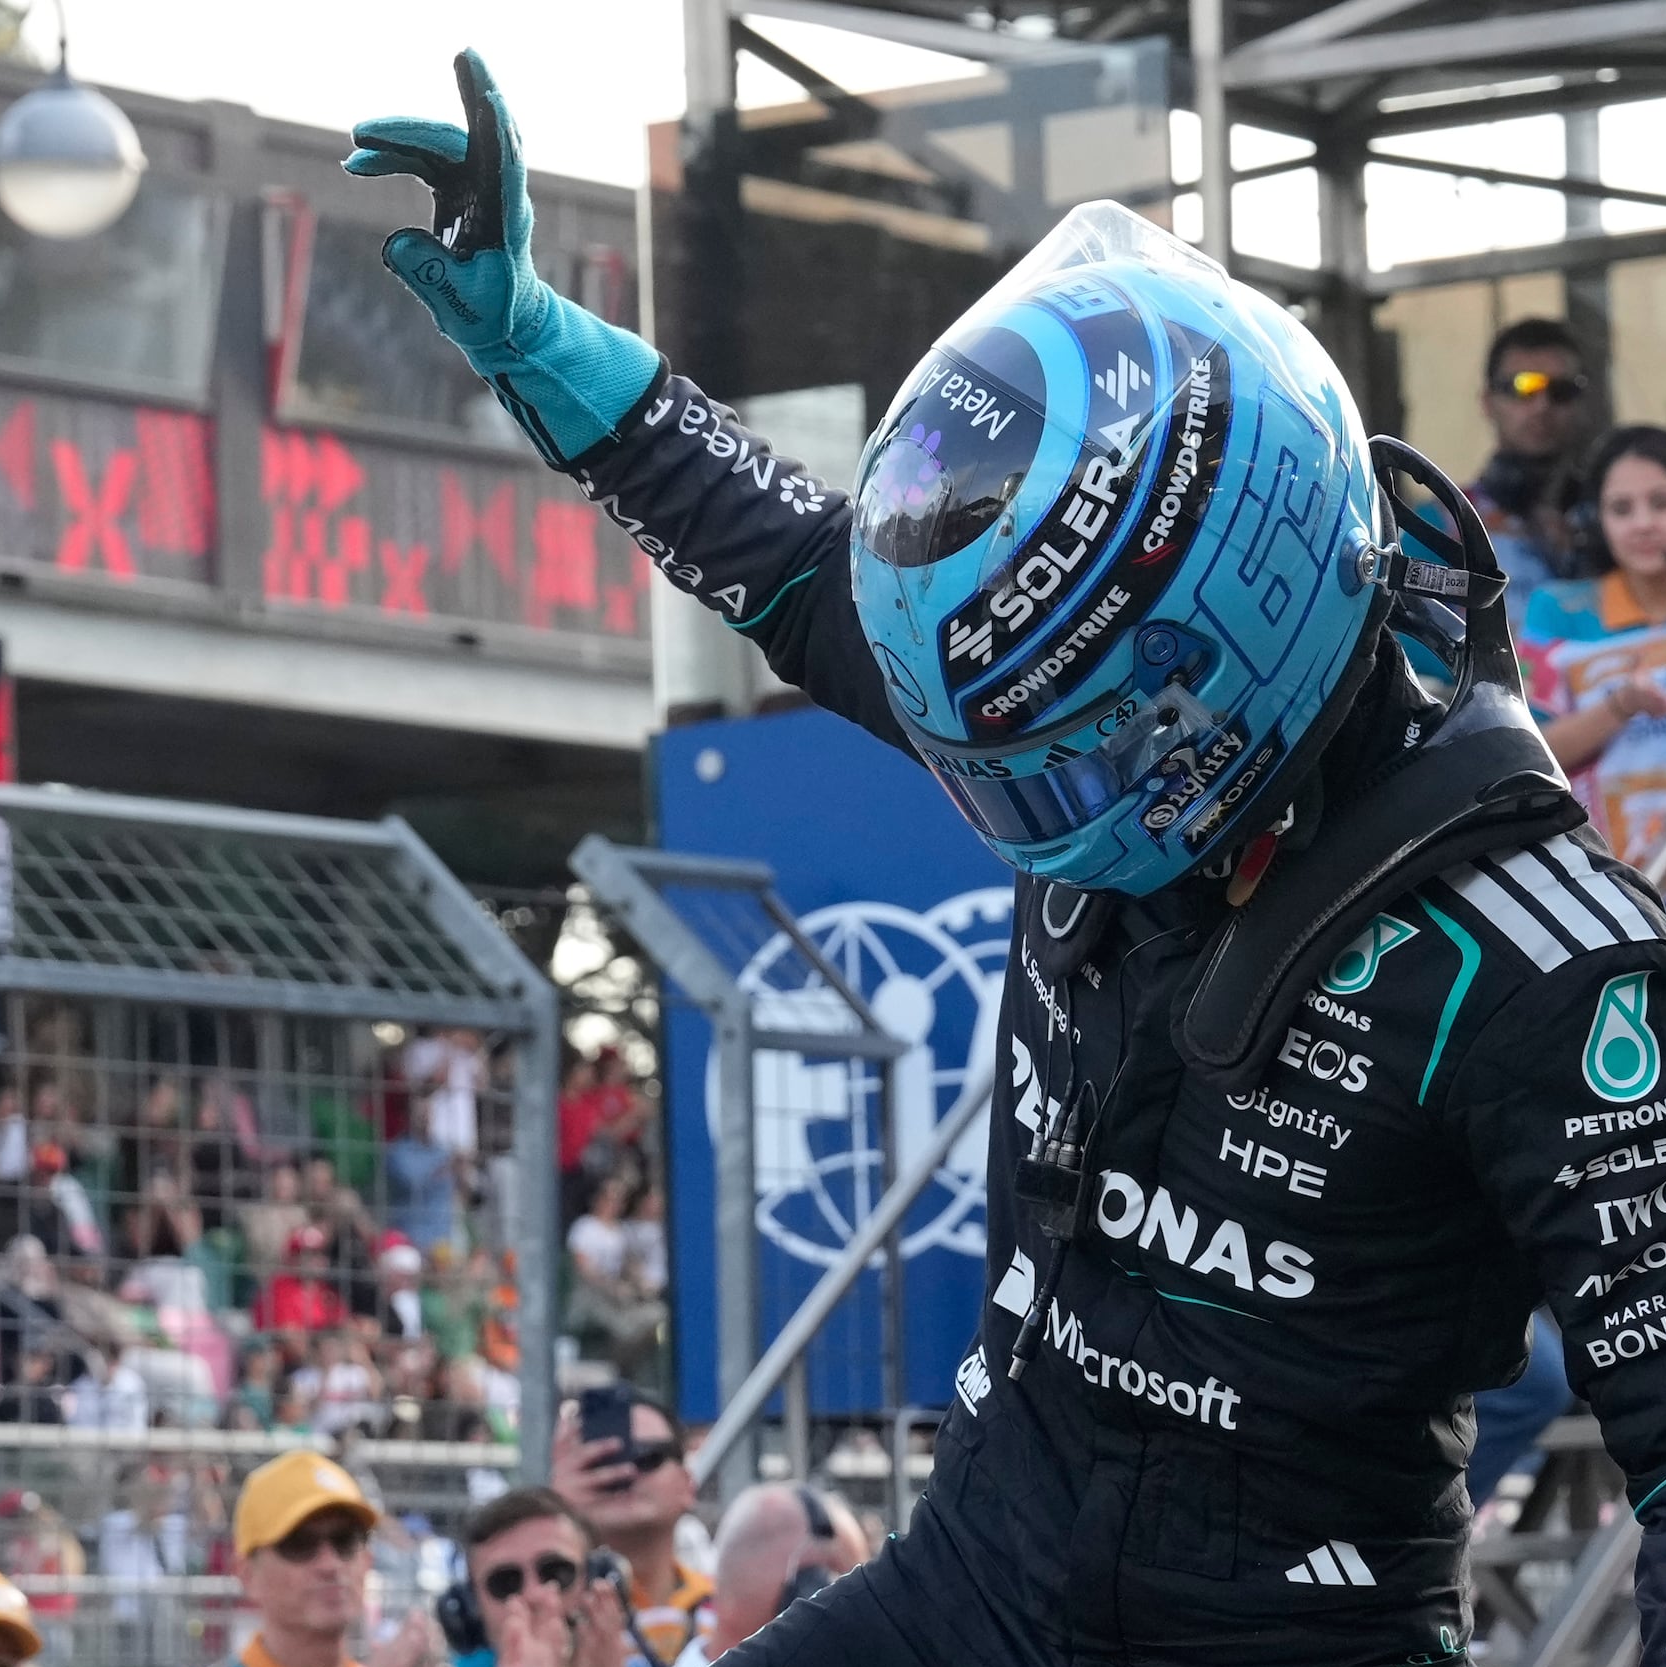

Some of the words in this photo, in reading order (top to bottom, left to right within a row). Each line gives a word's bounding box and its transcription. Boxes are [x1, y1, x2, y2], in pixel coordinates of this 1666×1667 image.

[941, 371, 1017, 441] Meta
[1142, 356, 1212, 554] CROWDSTRIKE
[990, 412, 1141, 633] SOLERA
[982, 585, 1131, 718] CROWDSTRIKE
[1218, 1128, 1328, 1199] HPE
[957, 1352, 992, 1400] OMP
[1044, 1297, 1242, 1431] Microsoft
